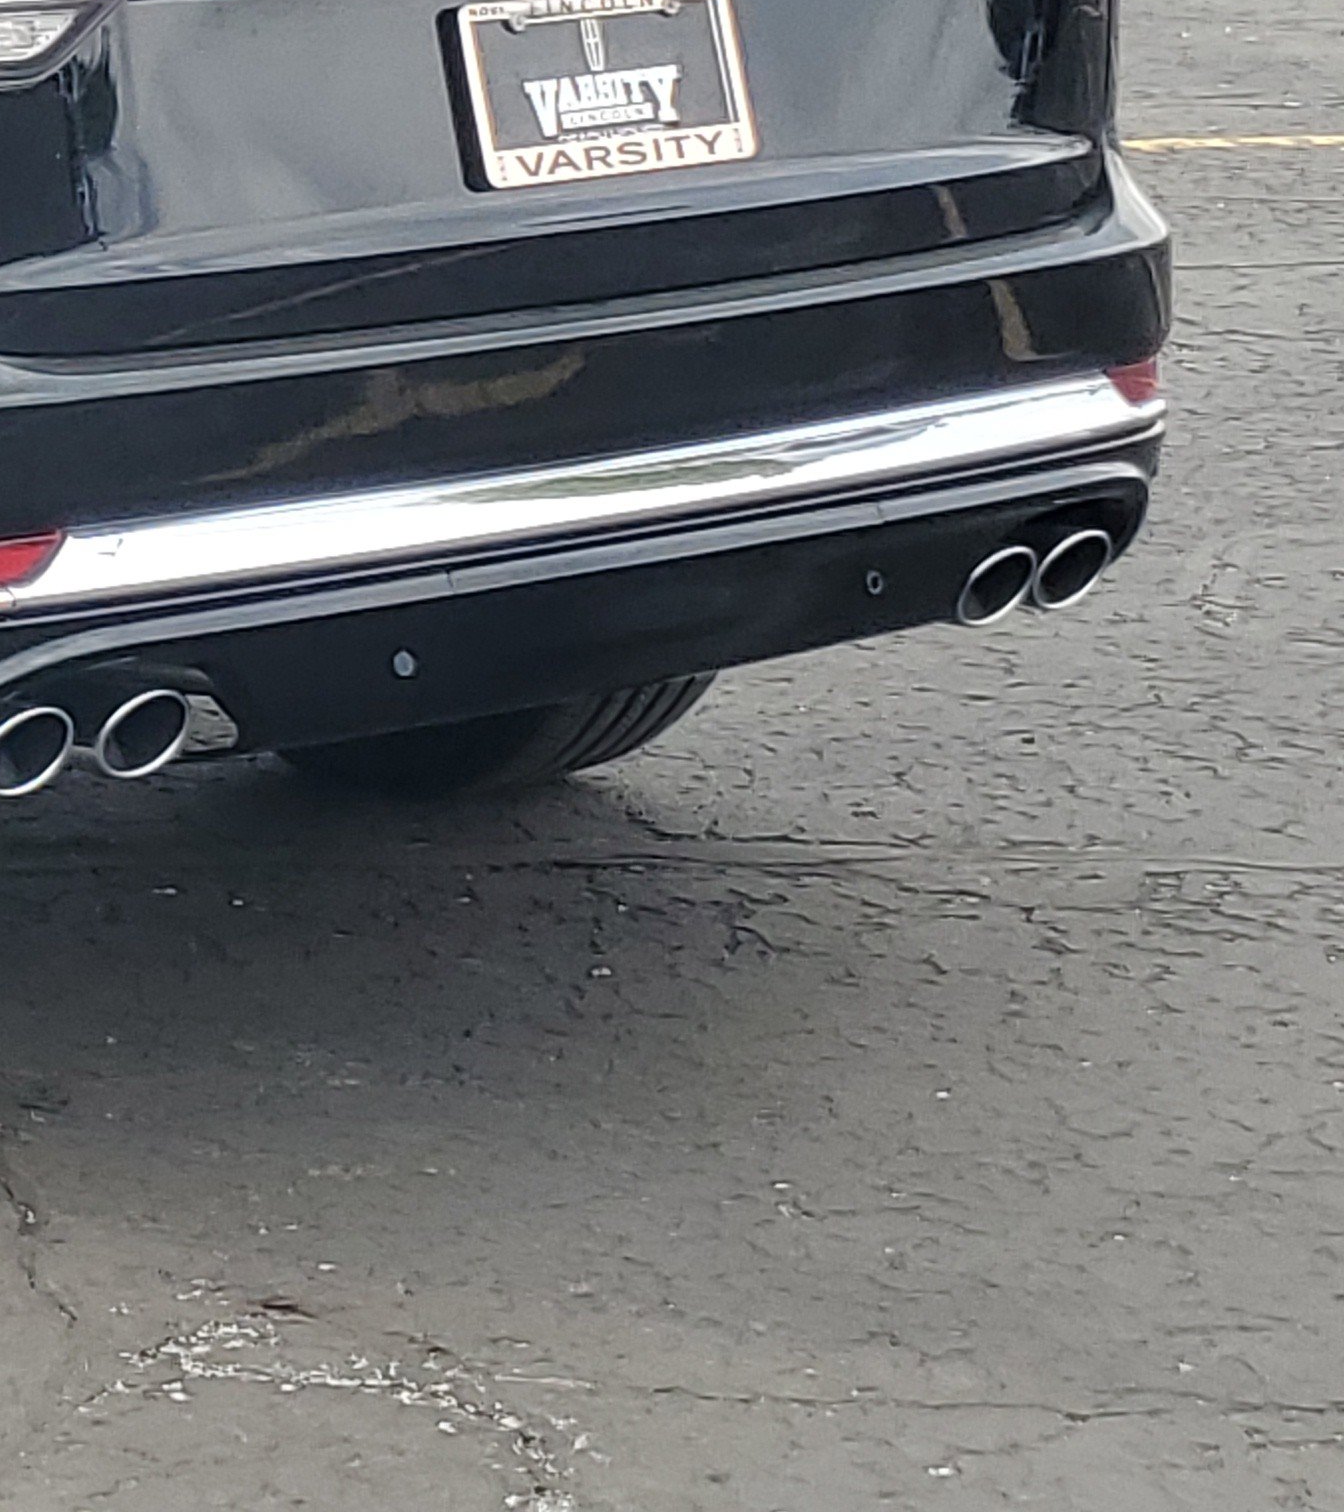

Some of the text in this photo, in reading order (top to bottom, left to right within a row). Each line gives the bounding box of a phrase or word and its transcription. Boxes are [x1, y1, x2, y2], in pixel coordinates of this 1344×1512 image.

[522, 64, 682, 139] VARSITY
[569, 108, 646, 126] LINCOLN
[516, 130, 723, 178] VARSITY
